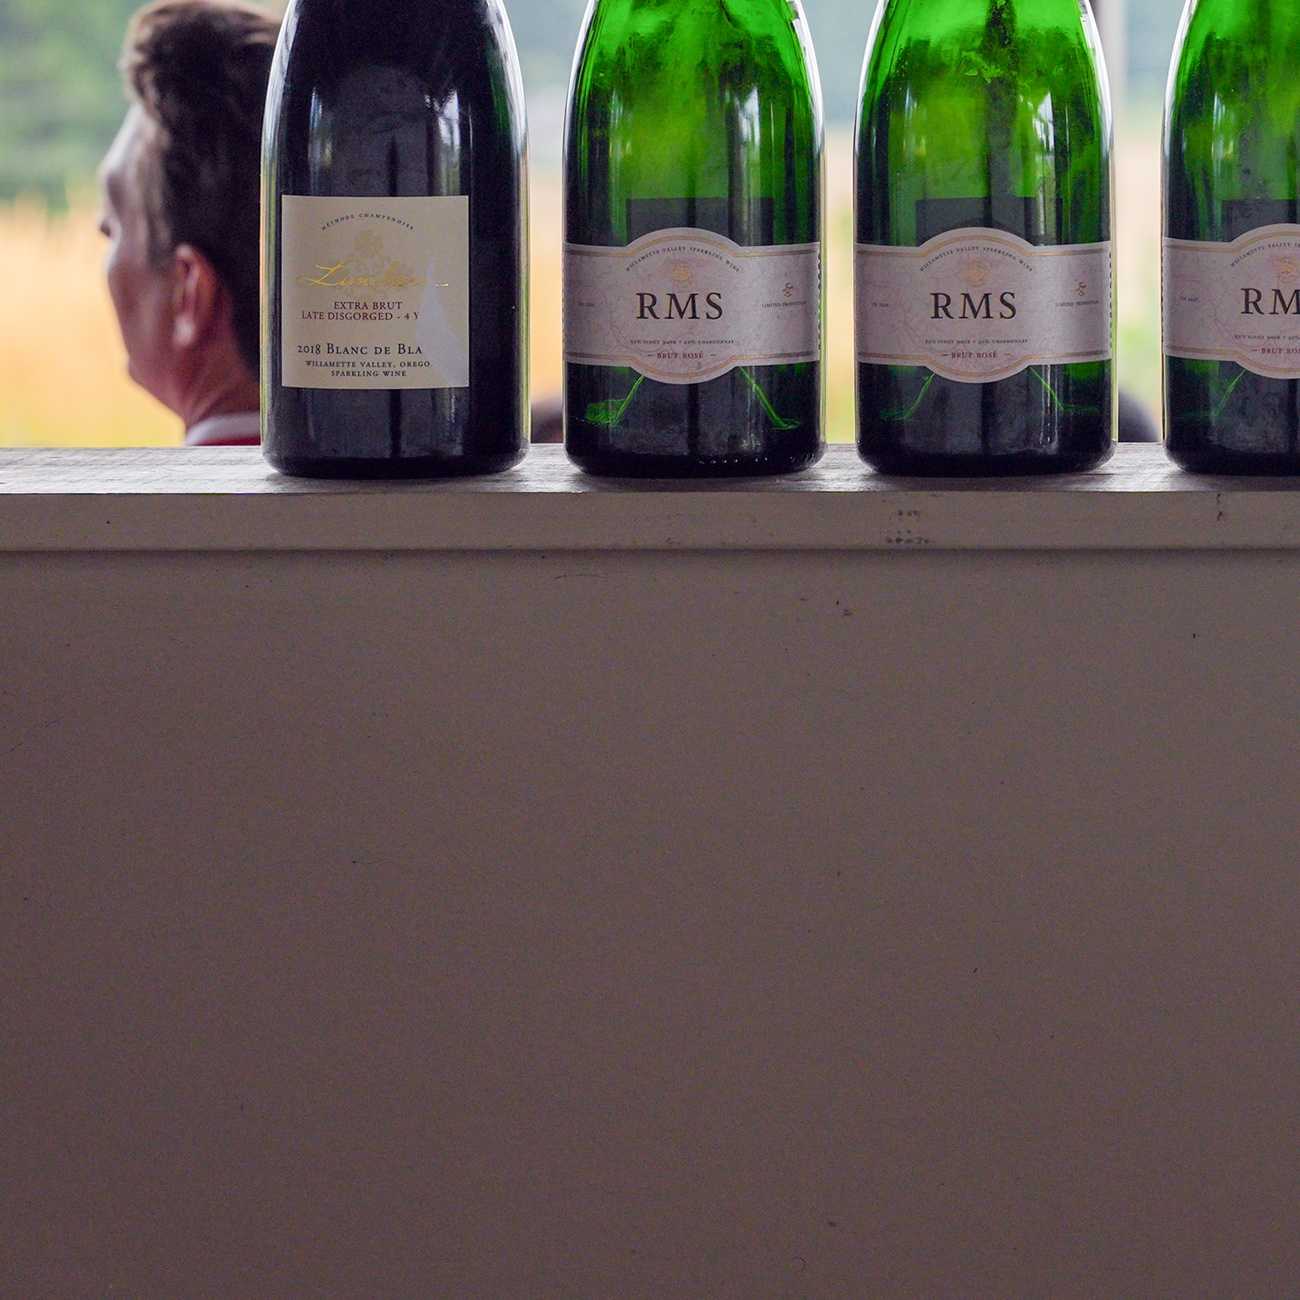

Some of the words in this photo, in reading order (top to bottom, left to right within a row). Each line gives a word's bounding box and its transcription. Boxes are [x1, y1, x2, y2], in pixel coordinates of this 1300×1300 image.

[321, 214, 355, 231] MÉTHODE
[359, 213, 415, 231] CHAMPENOISE
[626, 250, 660, 272] WILLAMETTE
[690, 247, 724, 261] SPARKLING
[726, 260, 740, 272] WINE
[920, 250, 954, 272] WILLAMETTE
[983, 247, 1017, 261] SPARKLING
[1019, 260, 1033, 272] WINE
[1230, 246, 1265, 267] WILLAMETTE
[334, 301, 369, 310] EXTRA
[373, 301, 403, 310] BRUT
[636, 292, 724, 320] RMS
[930, 292, 1017, 320] RMS
[302, 311, 324, 320] LATE
[328, 312, 393, 321] DISGORGED
[298, 345, 321, 354] 2018
[327, 343, 368, 355] BLANC
[374, 346, 391, 355] DE
[398, 343, 423, 355] BLA
[683, 351, 704, 359] ROSÉ
[976, 350, 998, 359] ROSÉ
[306, 360, 356, 368] WILLAMETTE
[360, 361, 396, 369] VALLEY,
